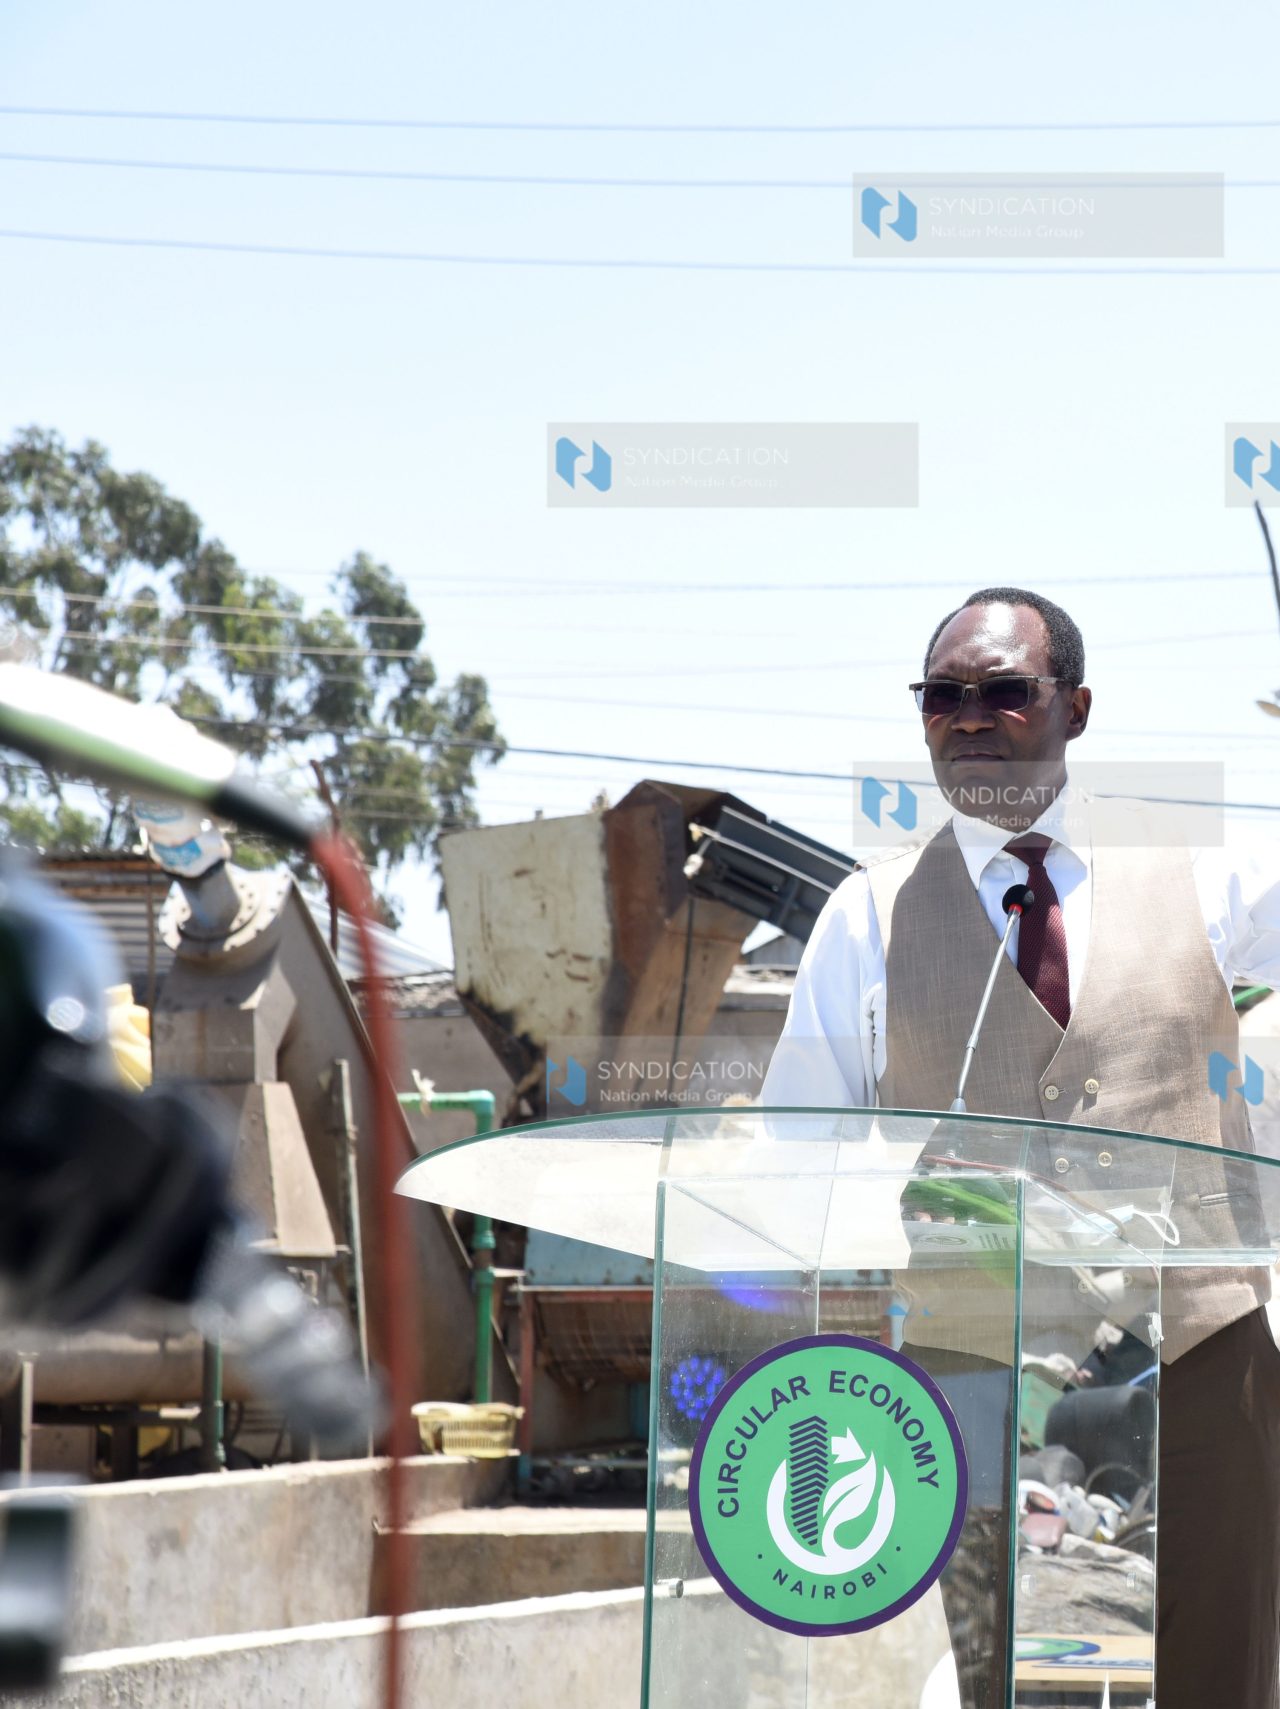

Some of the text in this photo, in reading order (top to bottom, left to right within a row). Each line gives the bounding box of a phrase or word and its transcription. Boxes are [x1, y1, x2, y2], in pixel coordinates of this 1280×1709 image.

[717, 1370, 939, 1518] CIRCULAR ECONOMY
[772, 1562, 888, 1599] NAIROBI
